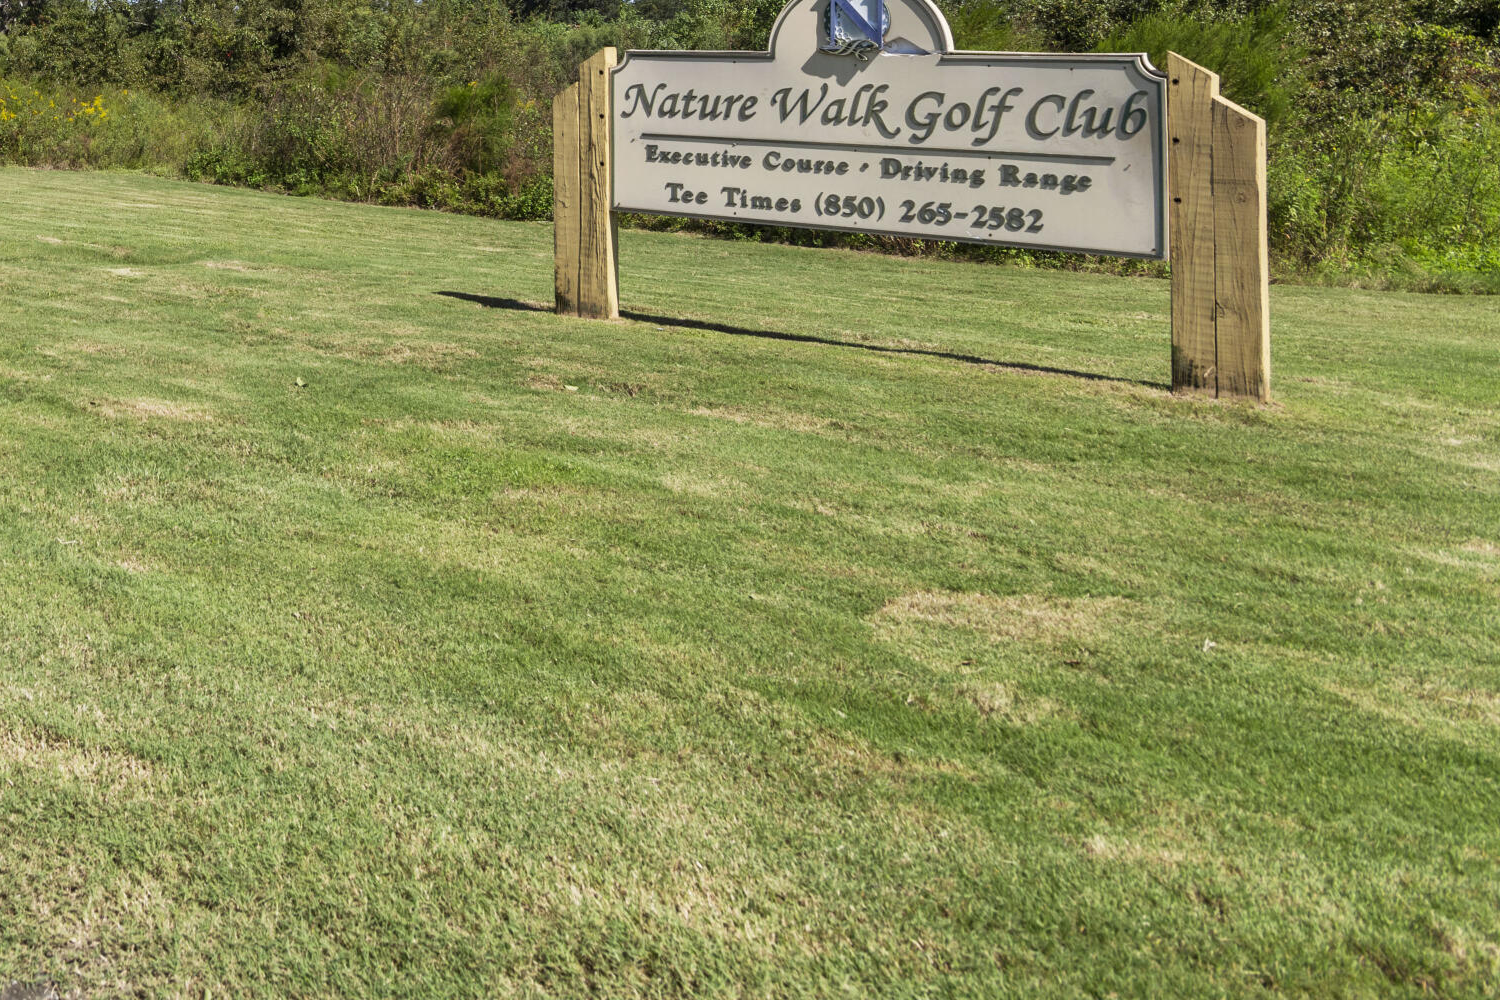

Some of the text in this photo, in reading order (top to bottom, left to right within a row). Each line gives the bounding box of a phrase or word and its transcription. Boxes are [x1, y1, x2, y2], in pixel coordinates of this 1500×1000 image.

[620, 83, 1149, 146] Nature Walk Golf Club
[645, 144, 1092, 195] Executive Course Driving Range
[665, 182, 1044, 234] Tee Times (850) 265-2582
